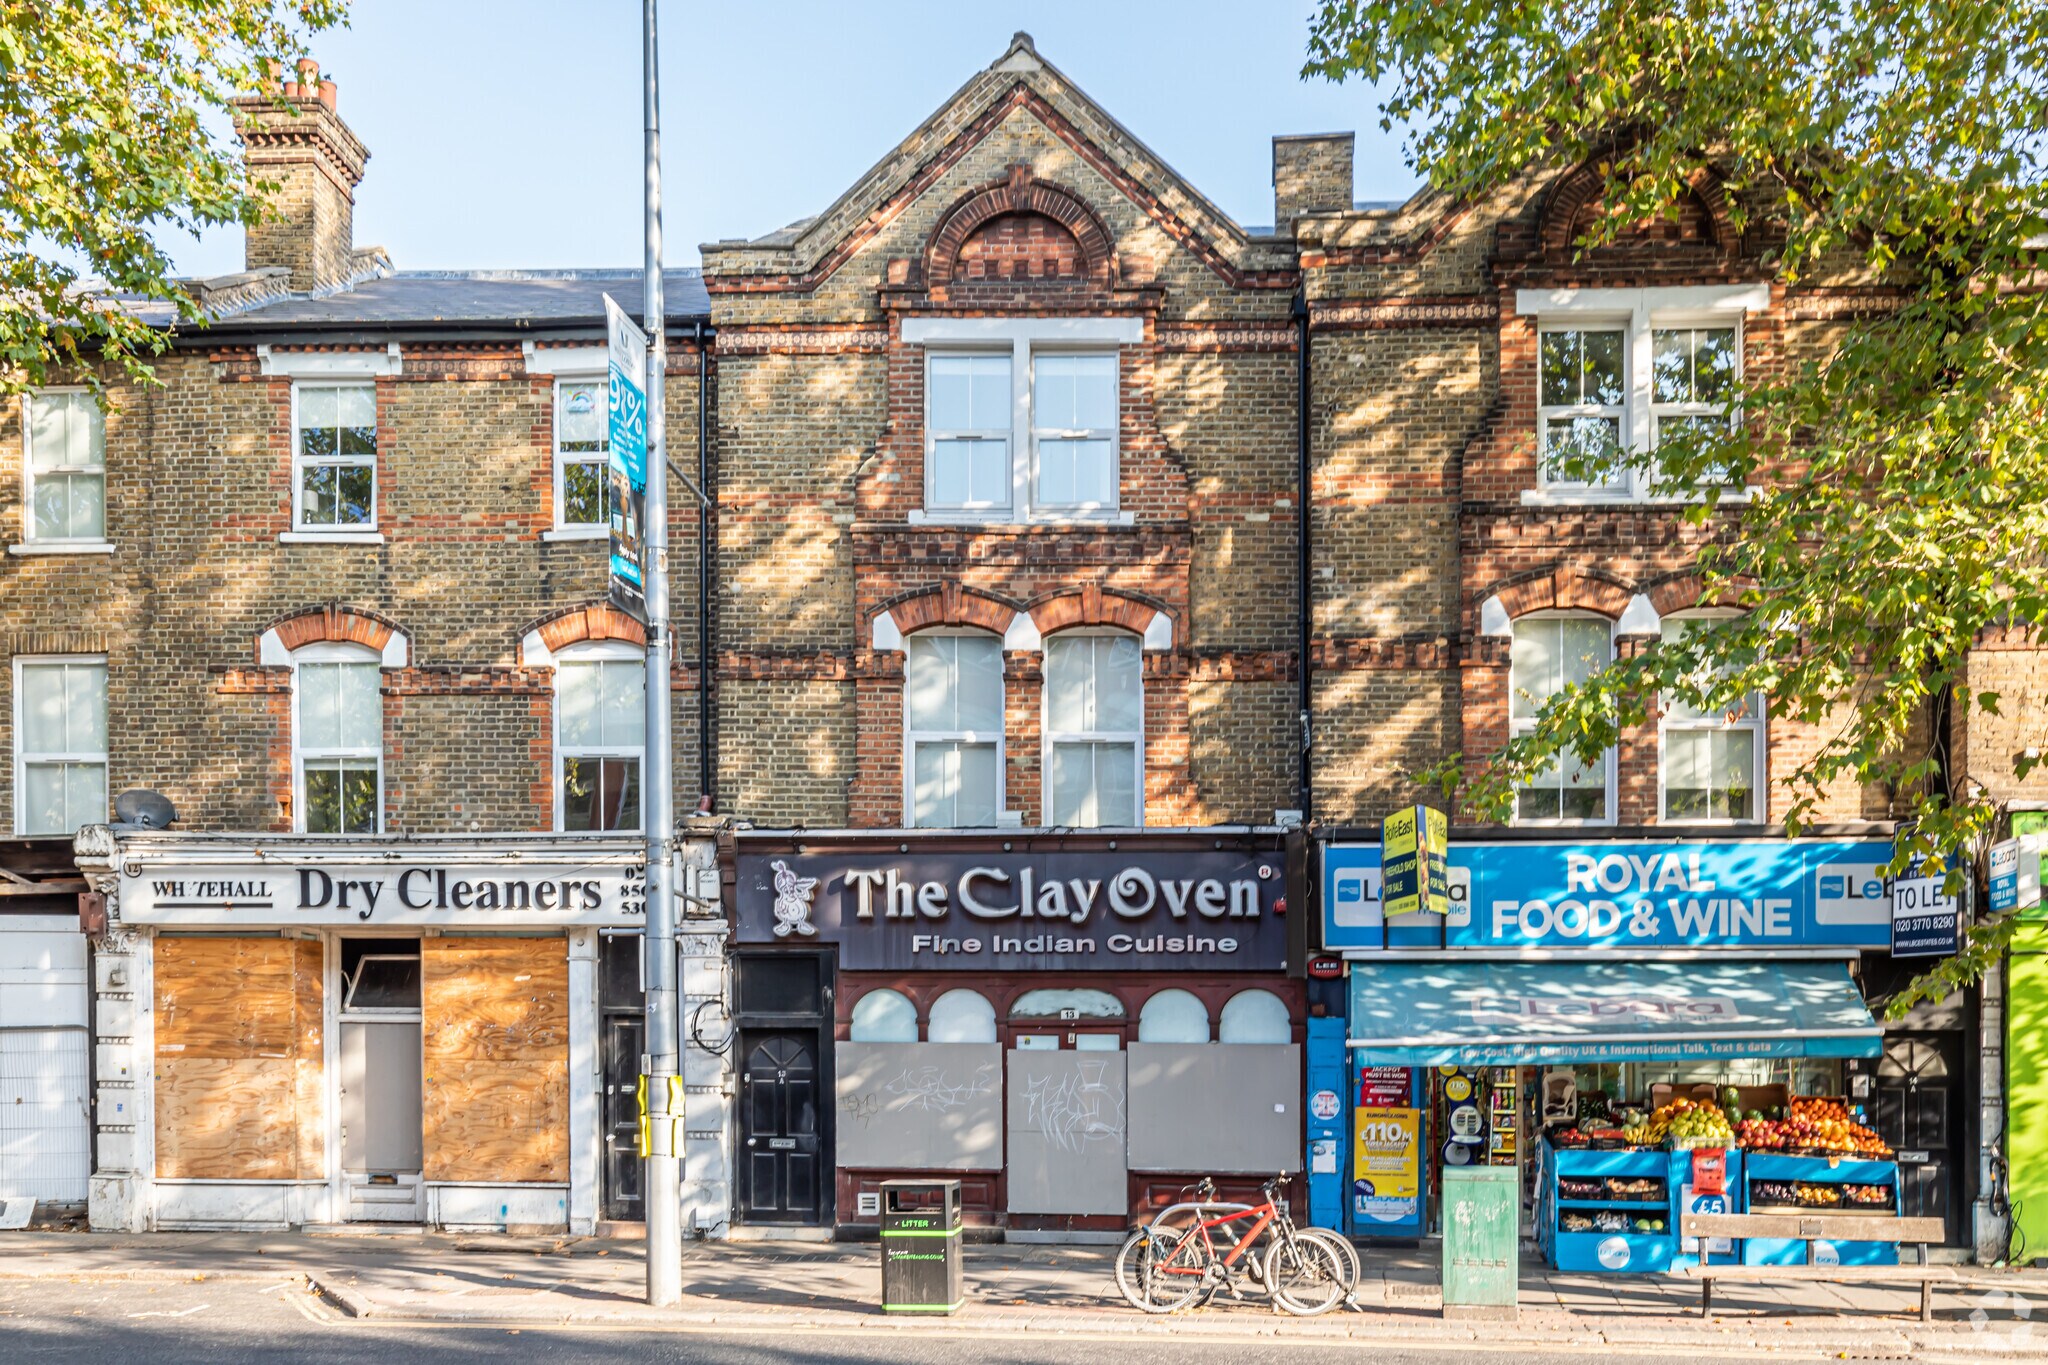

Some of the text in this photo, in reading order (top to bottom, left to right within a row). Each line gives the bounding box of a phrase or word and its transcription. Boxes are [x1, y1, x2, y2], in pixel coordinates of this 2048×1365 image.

[1404, 859, 1416, 872] SHOP
[1567, 853, 1716, 893] ROYAL
[152, 868, 602, 921] WHTEHALL Dry Cleaners
[844, 867, 949, 918] The
[958, 866, 1101, 924] Clay
[1108, 866, 1260, 918] Oven
[1393, 880, 1403, 893] SALE
[1896, 884, 1951, 911] TO LE
[1492, 898, 1792, 938] FOOD & WINE
[1895, 915, 1954, 933] 020 3770 8290
[912, 933, 1238, 953] Fine Indian Cuisine
[1529, 1000, 1723, 1016] Lebara
[1460, 1042, 1771, 1058] Low-Cost, High Quality UK & International Talk, Text & data
[1697, 1200, 1722, 1214] £5
[901, 1220, 929, 1228] LITTER
